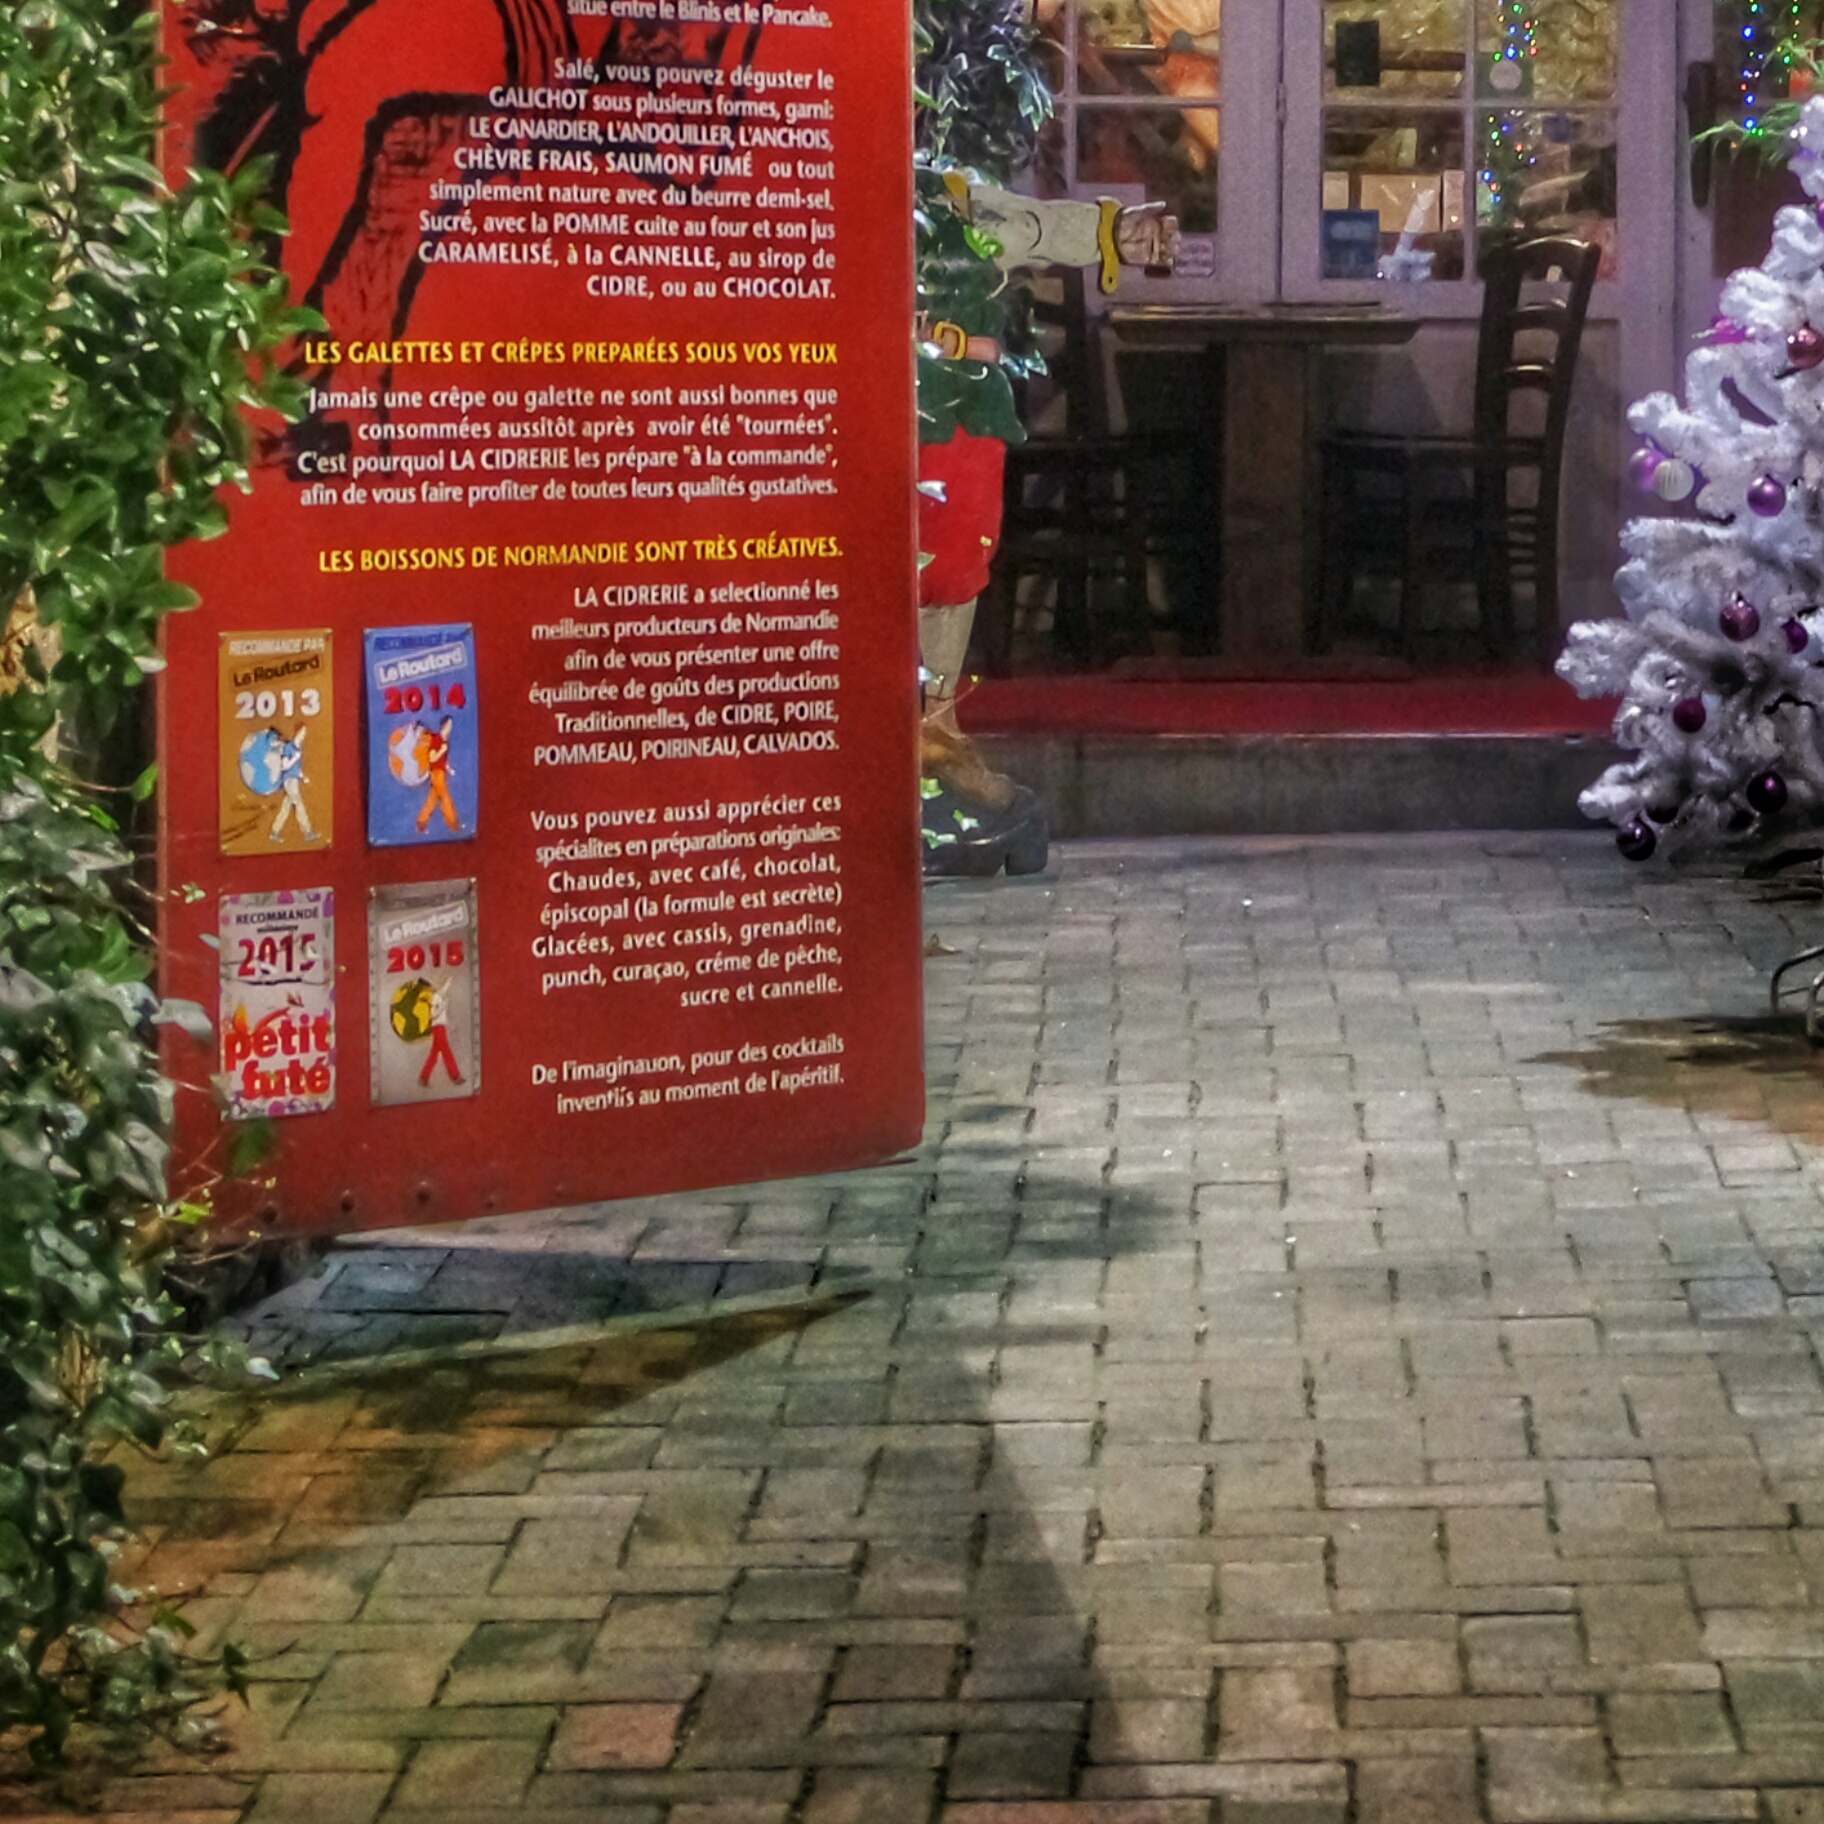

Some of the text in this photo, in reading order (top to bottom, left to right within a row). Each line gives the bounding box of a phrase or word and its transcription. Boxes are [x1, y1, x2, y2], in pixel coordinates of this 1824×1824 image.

[605, 64, 652, 83] vous
[655, 66, 725, 90] pouvez
[729, 64, 814, 94] déguster
[816, 67, 835, 91] le
[488, 85, 589, 111] GALICHOT
[592, 90, 633, 112] sous
[635, 90, 714, 120] plusieurs
[453, 142, 533, 171] CHÈVRE
[604, 150, 695, 176] SAUMON
[698, 151, 754, 178] FUMÉ
[768, 161, 793, 179] ou
[796, 159, 835, 180] tout
[566, 242, 579, 266] à
[584, 243, 604, 266] la
[727, 251, 752, 268] au
[758, 246, 807, 275] sirop
[812, 247, 836, 270] de
[586, 274, 836, 301] CIDRE, ou au CHOCOLAT.
[304, 336, 838, 364] LES GALETTES ET CRÊPES PREPARÉES SOUS VOS YEUX
[308, 383, 838, 414] Jamais une crêpe ou galette ne sont aussi bonnes que
[357, 415, 492, 441] consommées
[497, 415, 576, 439] aussitôt
[581, 414, 636, 444] après
[646, 414, 696, 437] avoir
[700, 412, 731, 437] été
[352, 448, 445, 480] pourquoi
[449, 448, 476, 471] LA
[480, 447, 570, 471] CIDRERIE
[573, 446, 601, 469] les
[605, 444, 679, 475] prépare
[705, 444, 723, 467] la
[318, 532, 844, 573] LES BOISSONS DE NORMANDIE SONT TRÈS CRÉATIVES.
[573, 578, 840, 608] LA CIDRERIE a selectionné les
[234, 688, 321, 719] 2013
[383, 683, 466, 713] 2014
[530, 793, 842, 834] Vous pouvez aussi apprécier ces
[648, 866, 694, 886] avec
[386, 940, 465, 973] 2015
[680, 987, 731, 1008] sucre
[735, 981, 755, 1002] et
[223, 1012, 329, 1072] petit
[241, 1056, 331, 1100] futé
